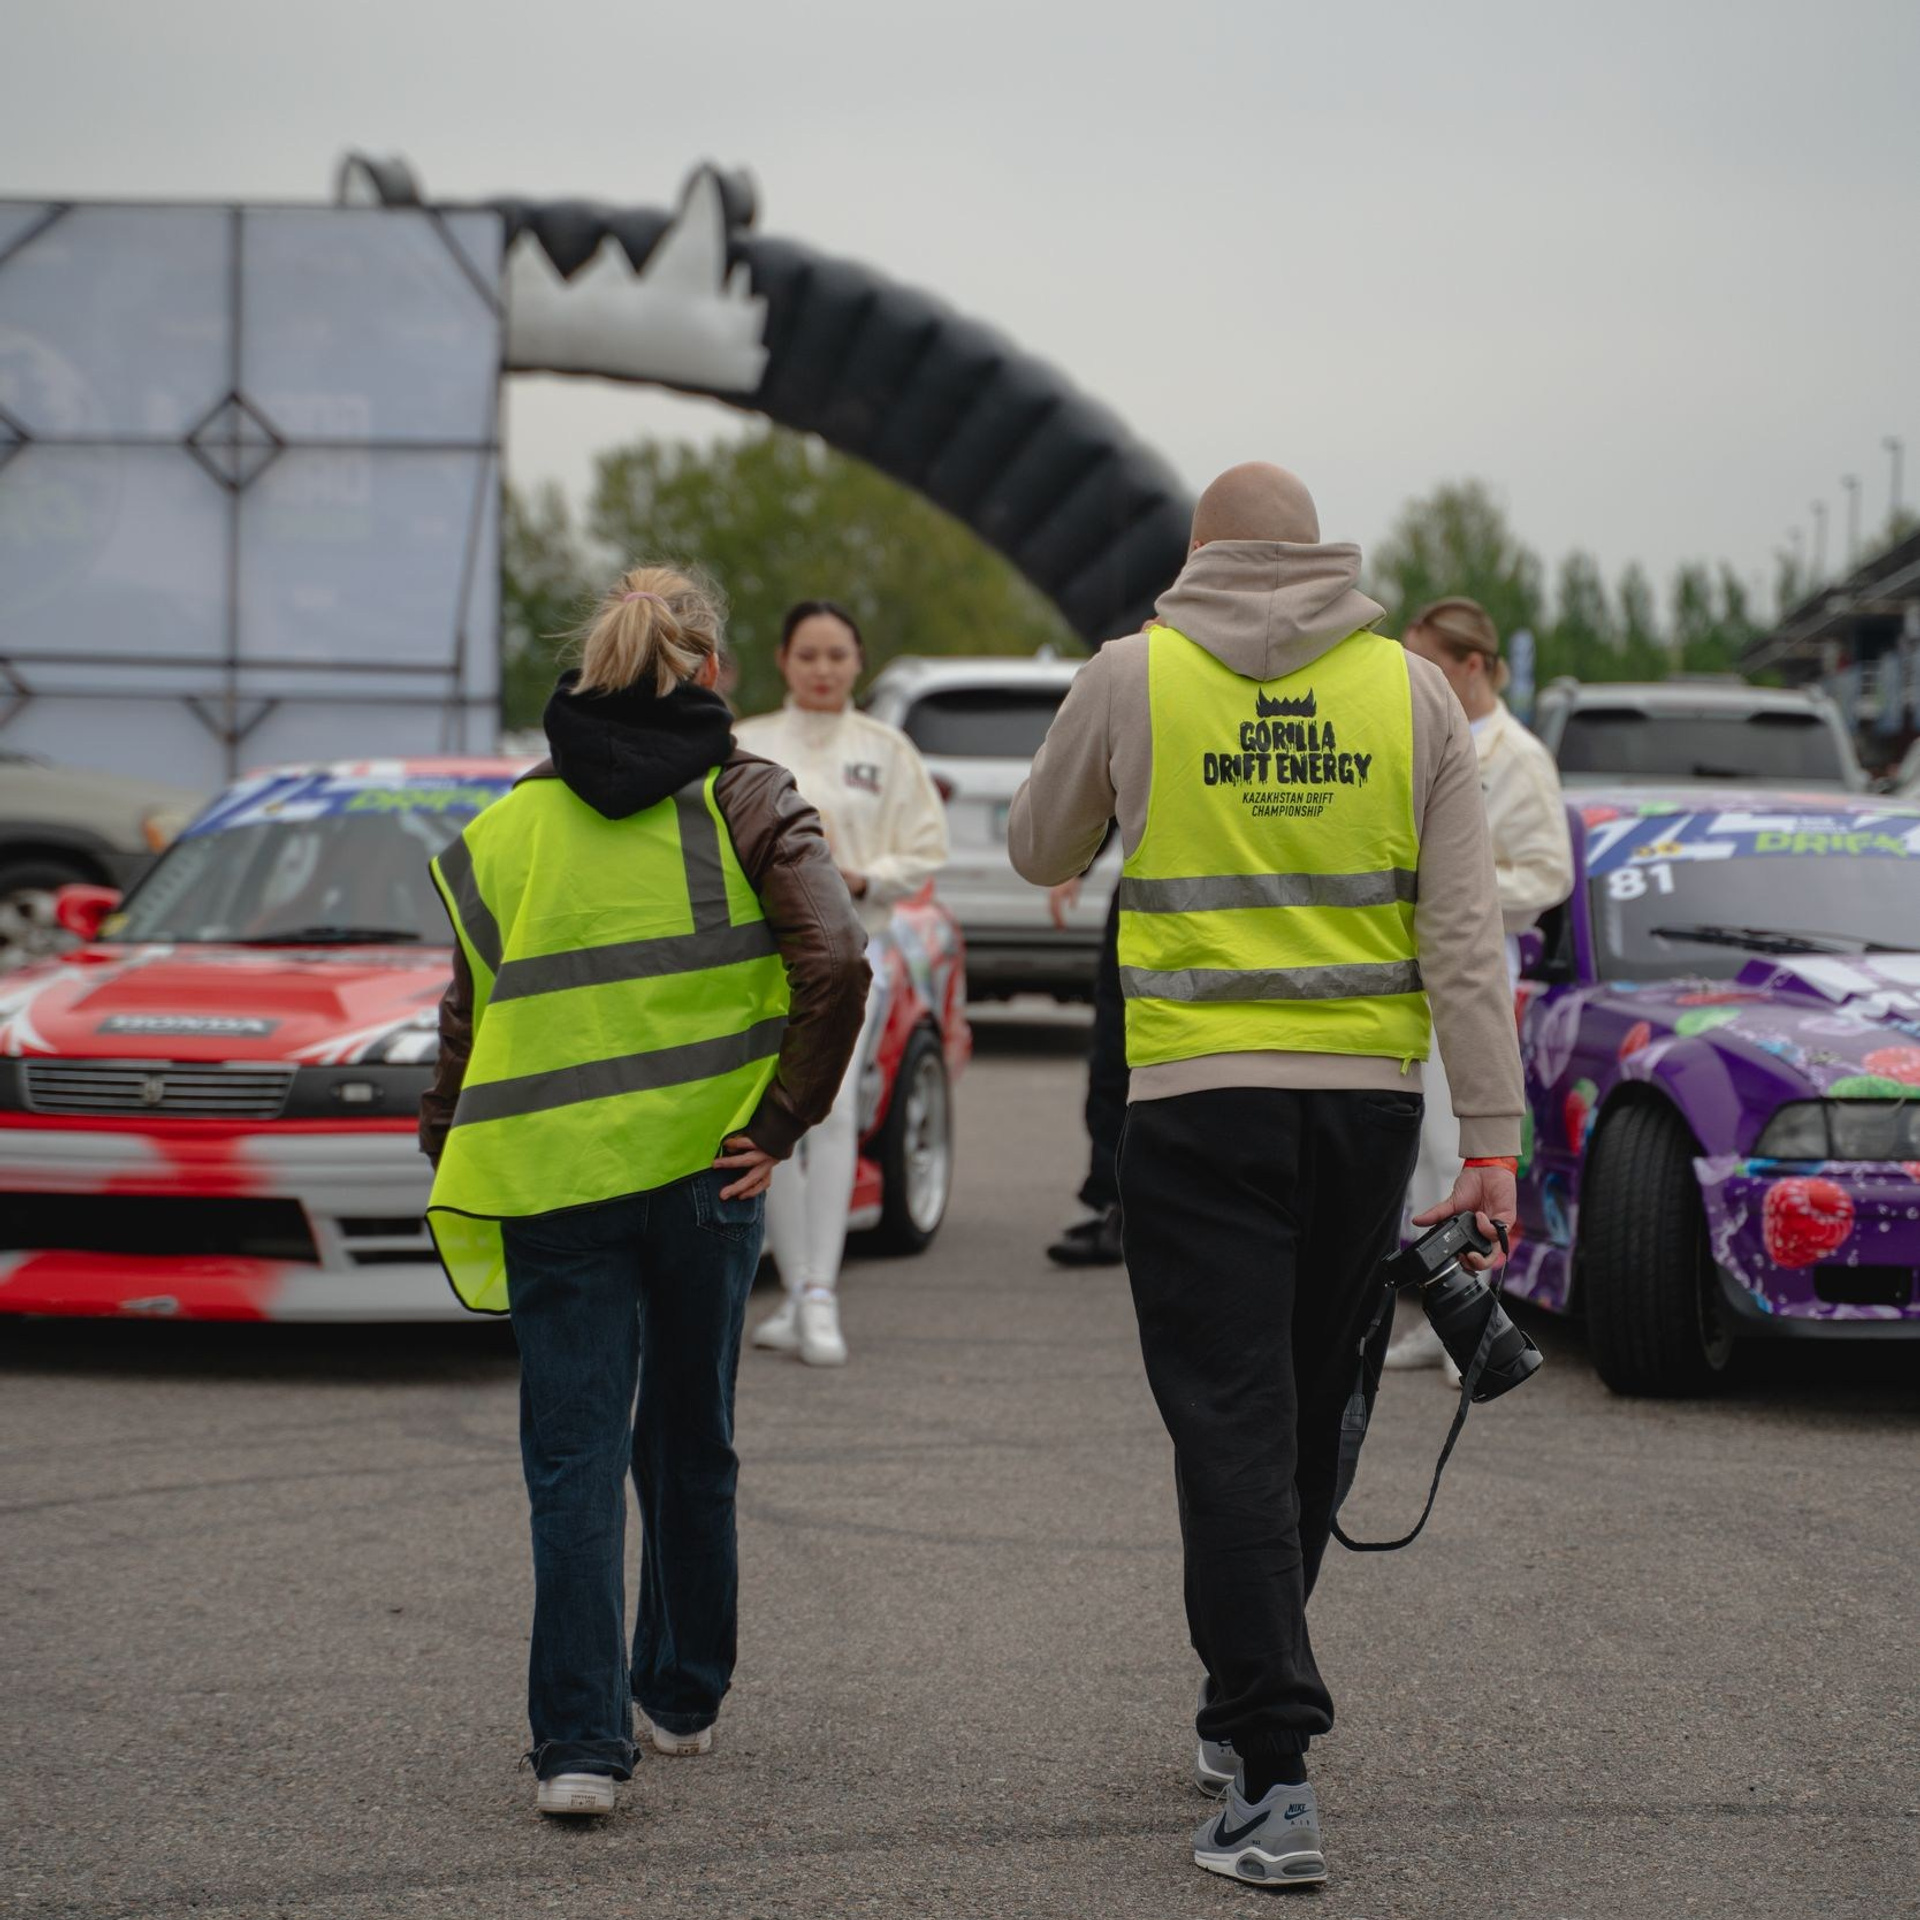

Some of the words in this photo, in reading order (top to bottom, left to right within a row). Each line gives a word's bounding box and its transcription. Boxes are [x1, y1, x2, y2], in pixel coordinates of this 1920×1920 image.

[1239, 720, 1336, 752] GORILLA
[1203, 752, 1271, 787] DRIFT
[1276, 752, 1372, 788] ENERGY
[1242, 792, 1304, 804] KAZAKHSTAN
[1306, 792, 1334, 804] DRIFT
[1252, 805, 1324, 817] CHAMPIONSHIP
[1608, 864, 1674, 900] 81
